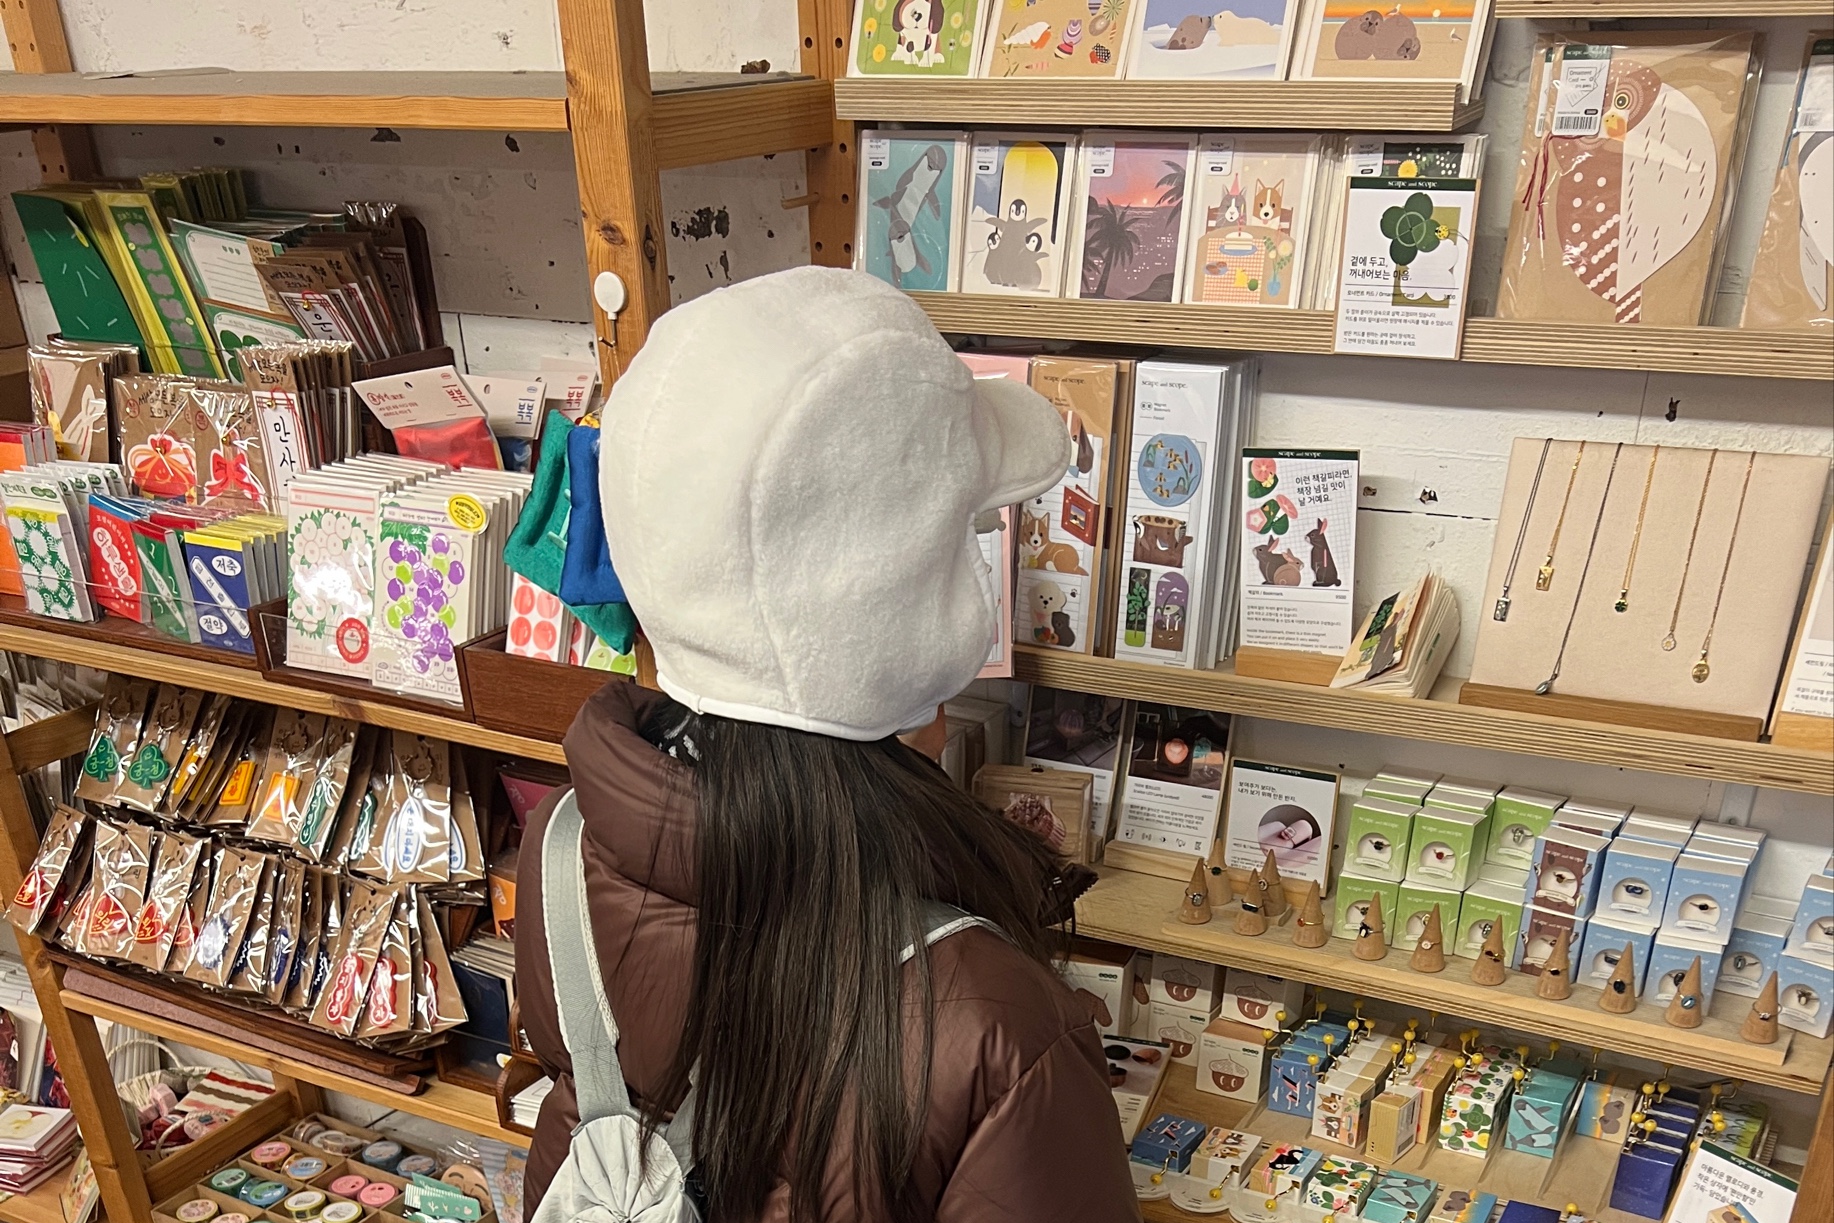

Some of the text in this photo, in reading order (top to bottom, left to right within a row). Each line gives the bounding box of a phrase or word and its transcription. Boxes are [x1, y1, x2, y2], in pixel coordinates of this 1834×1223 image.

[1351, 256, 1388, 268] 곁에 두고,
[1349, 269, 1412, 281] 꺼내어보는 마음.
[1295, 469, 1352, 486] 이런 책갈피라면,
[1297, 480, 1346, 496] 책장 넘길 맛이
[216, 558, 237, 575] 저축
[203, 617, 223, 633] 절약
[1238, 781, 1259, 790] 보여주기
[1697, 1174, 1709, 1182] 작은
[1710, 1180, 1728, 1191] 상자에
[1701, 1164, 1725, 1178] 아름다운
[1725, 1175, 1750, 1189] 멜로디와
